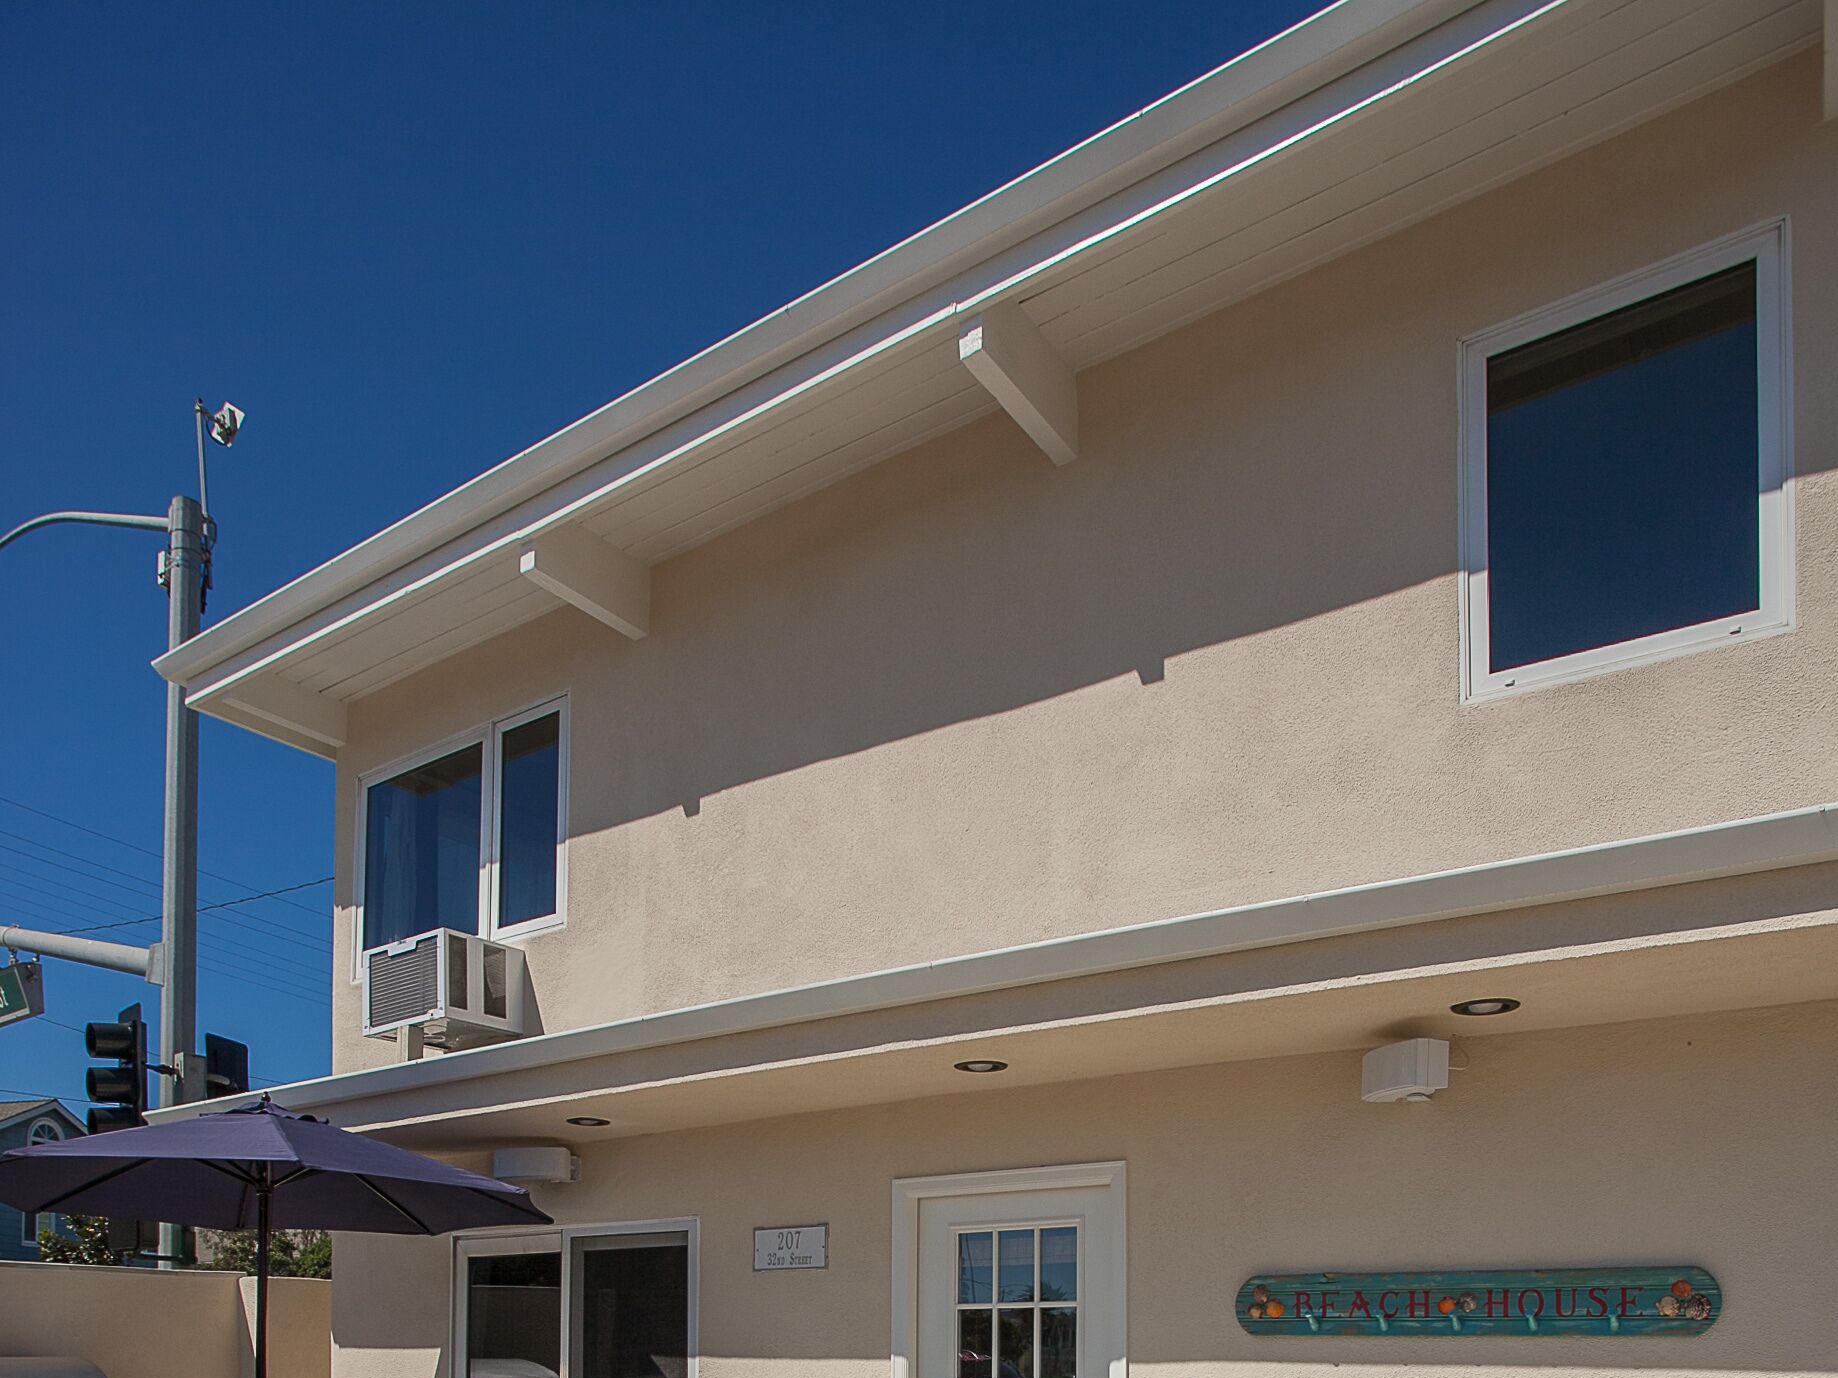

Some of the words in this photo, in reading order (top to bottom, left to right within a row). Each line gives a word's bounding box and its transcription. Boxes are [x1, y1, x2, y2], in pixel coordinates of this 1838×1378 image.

[777, 1231, 801, 1250] 207
[1293, 1289, 1430, 1319] BEACH
[1483, 1286, 1645, 1319] HOUSE
